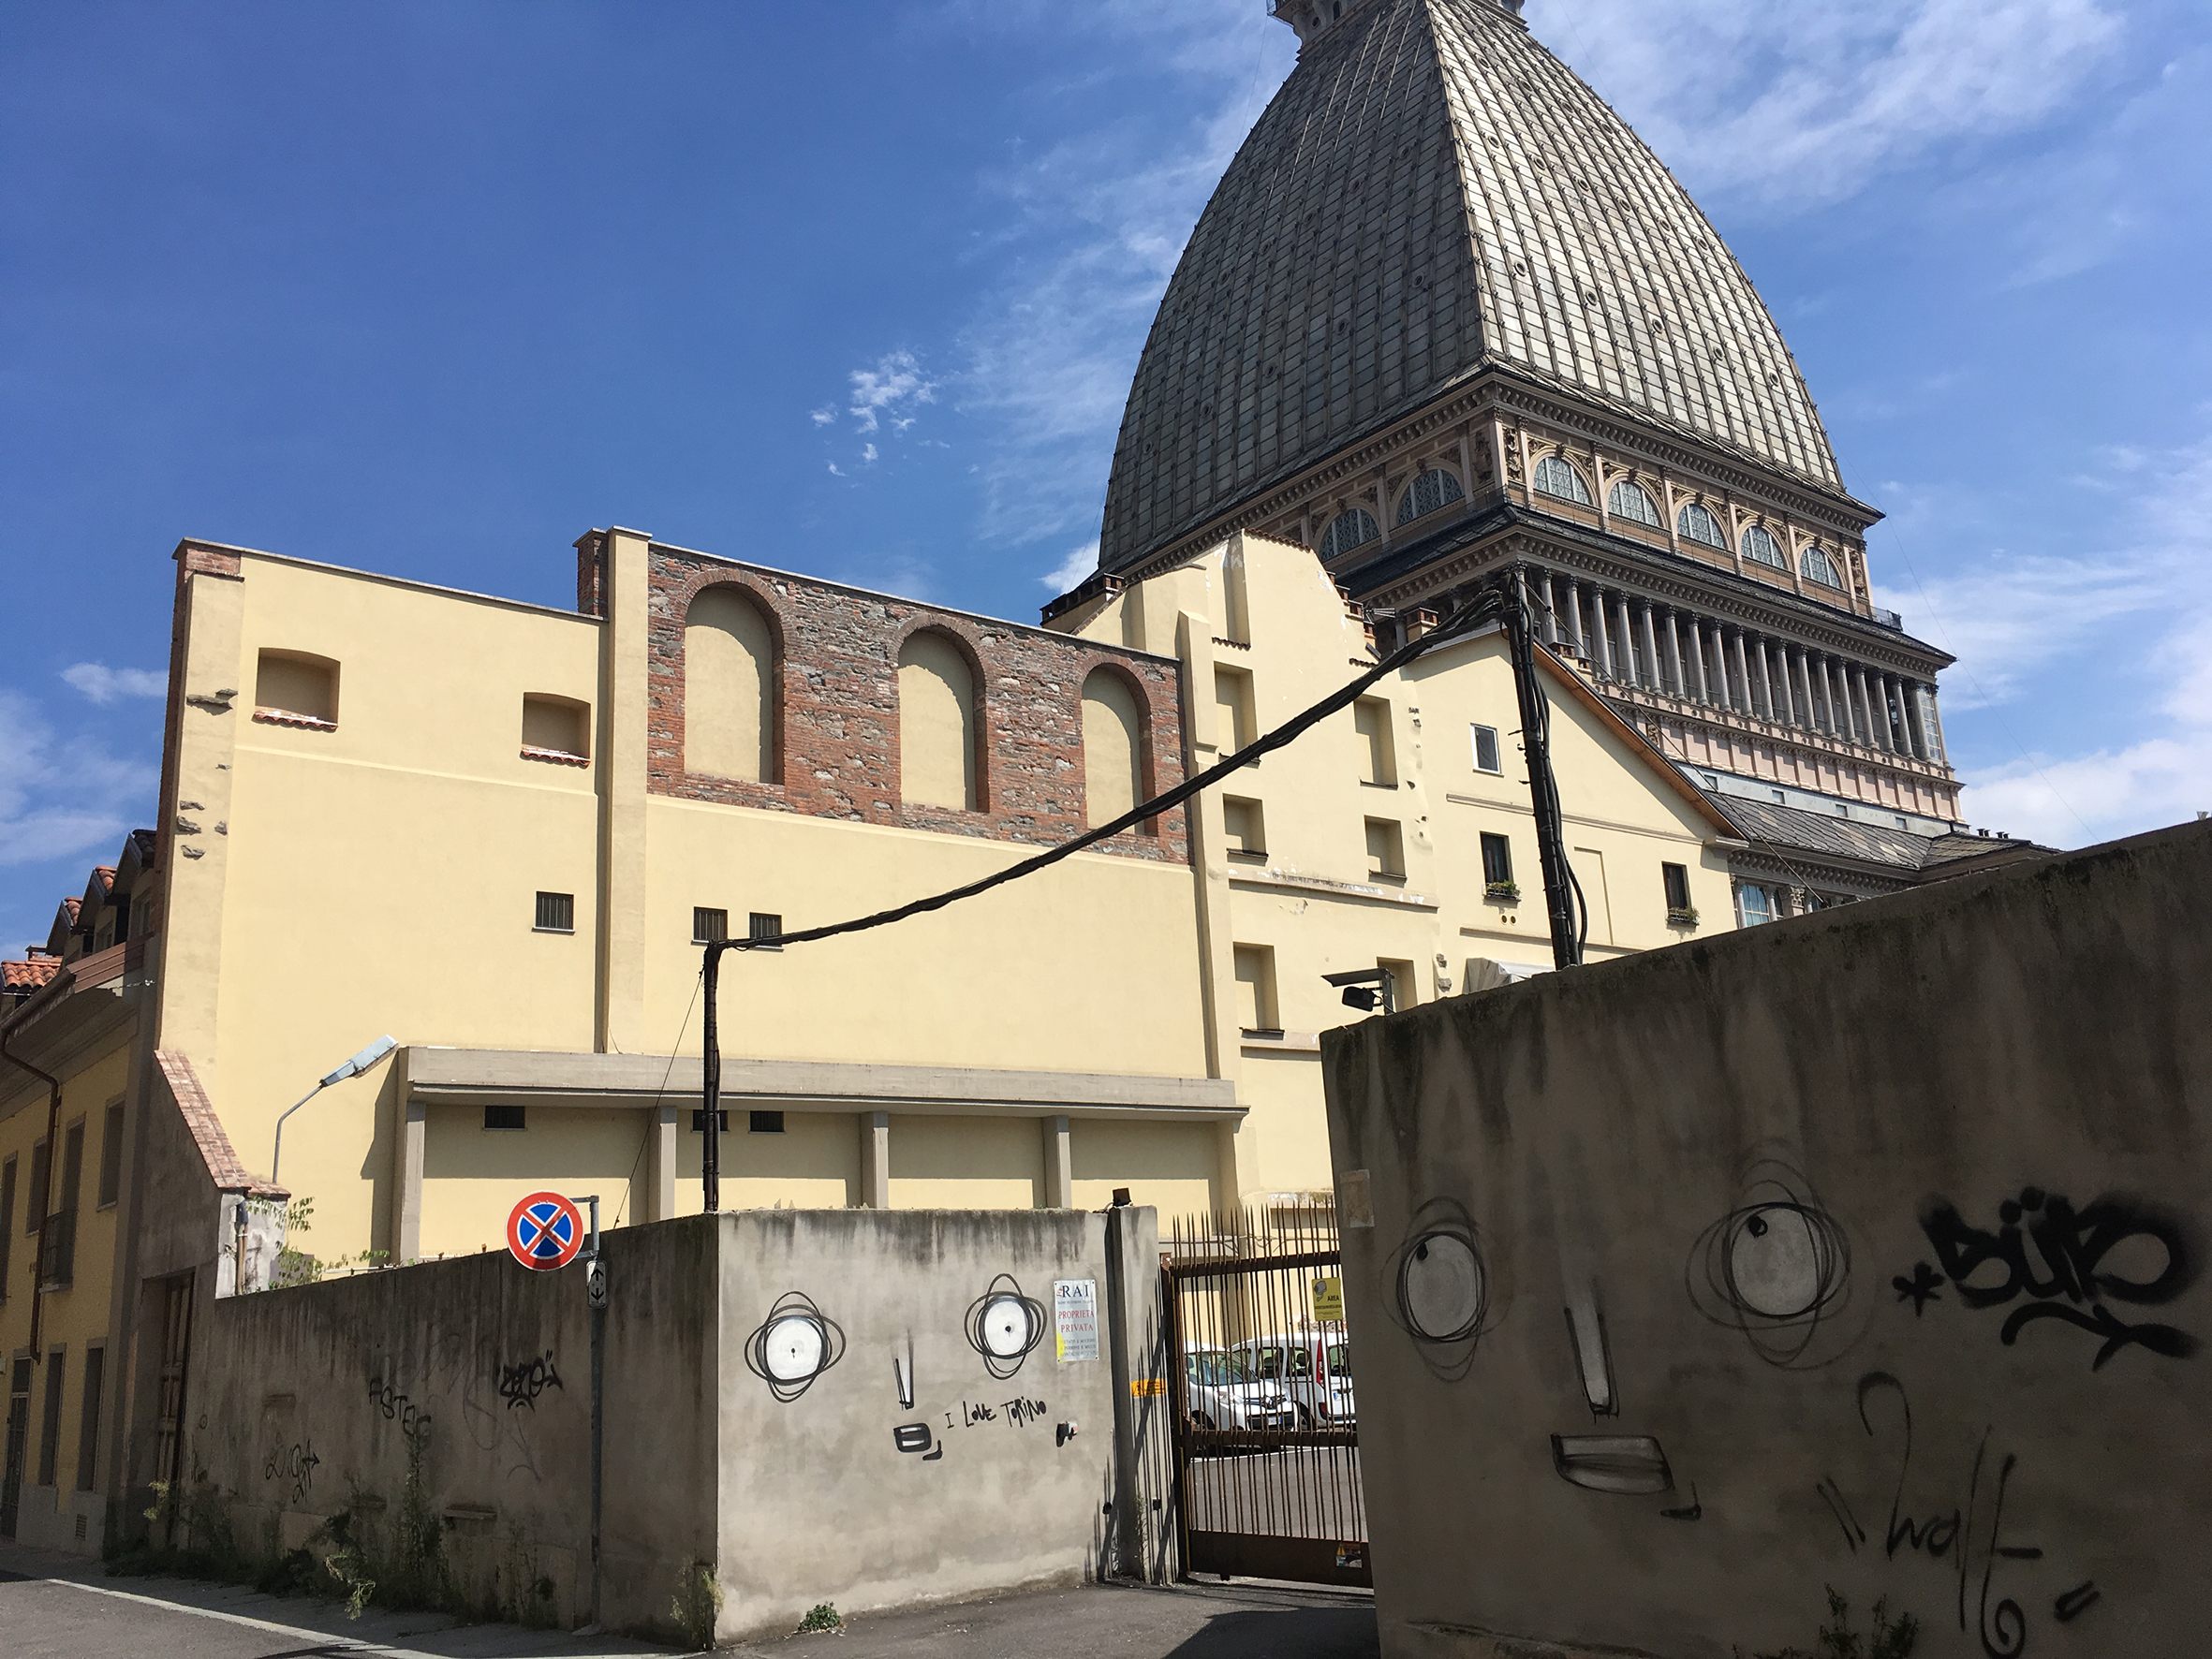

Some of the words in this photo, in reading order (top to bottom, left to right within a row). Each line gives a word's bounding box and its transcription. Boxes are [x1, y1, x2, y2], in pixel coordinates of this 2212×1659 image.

[1062, 1285, 1089, 1298] RAI
[1058, 1309, 1095, 1319] PROPRIETÀ
[1060, 1323, 1094, 1333] PRIVATA
[945, 1412, 954, 1429] I
[963, 1401, 997, 1428] LOVE
[1000, 1396, 1047, 1428] TORINO
